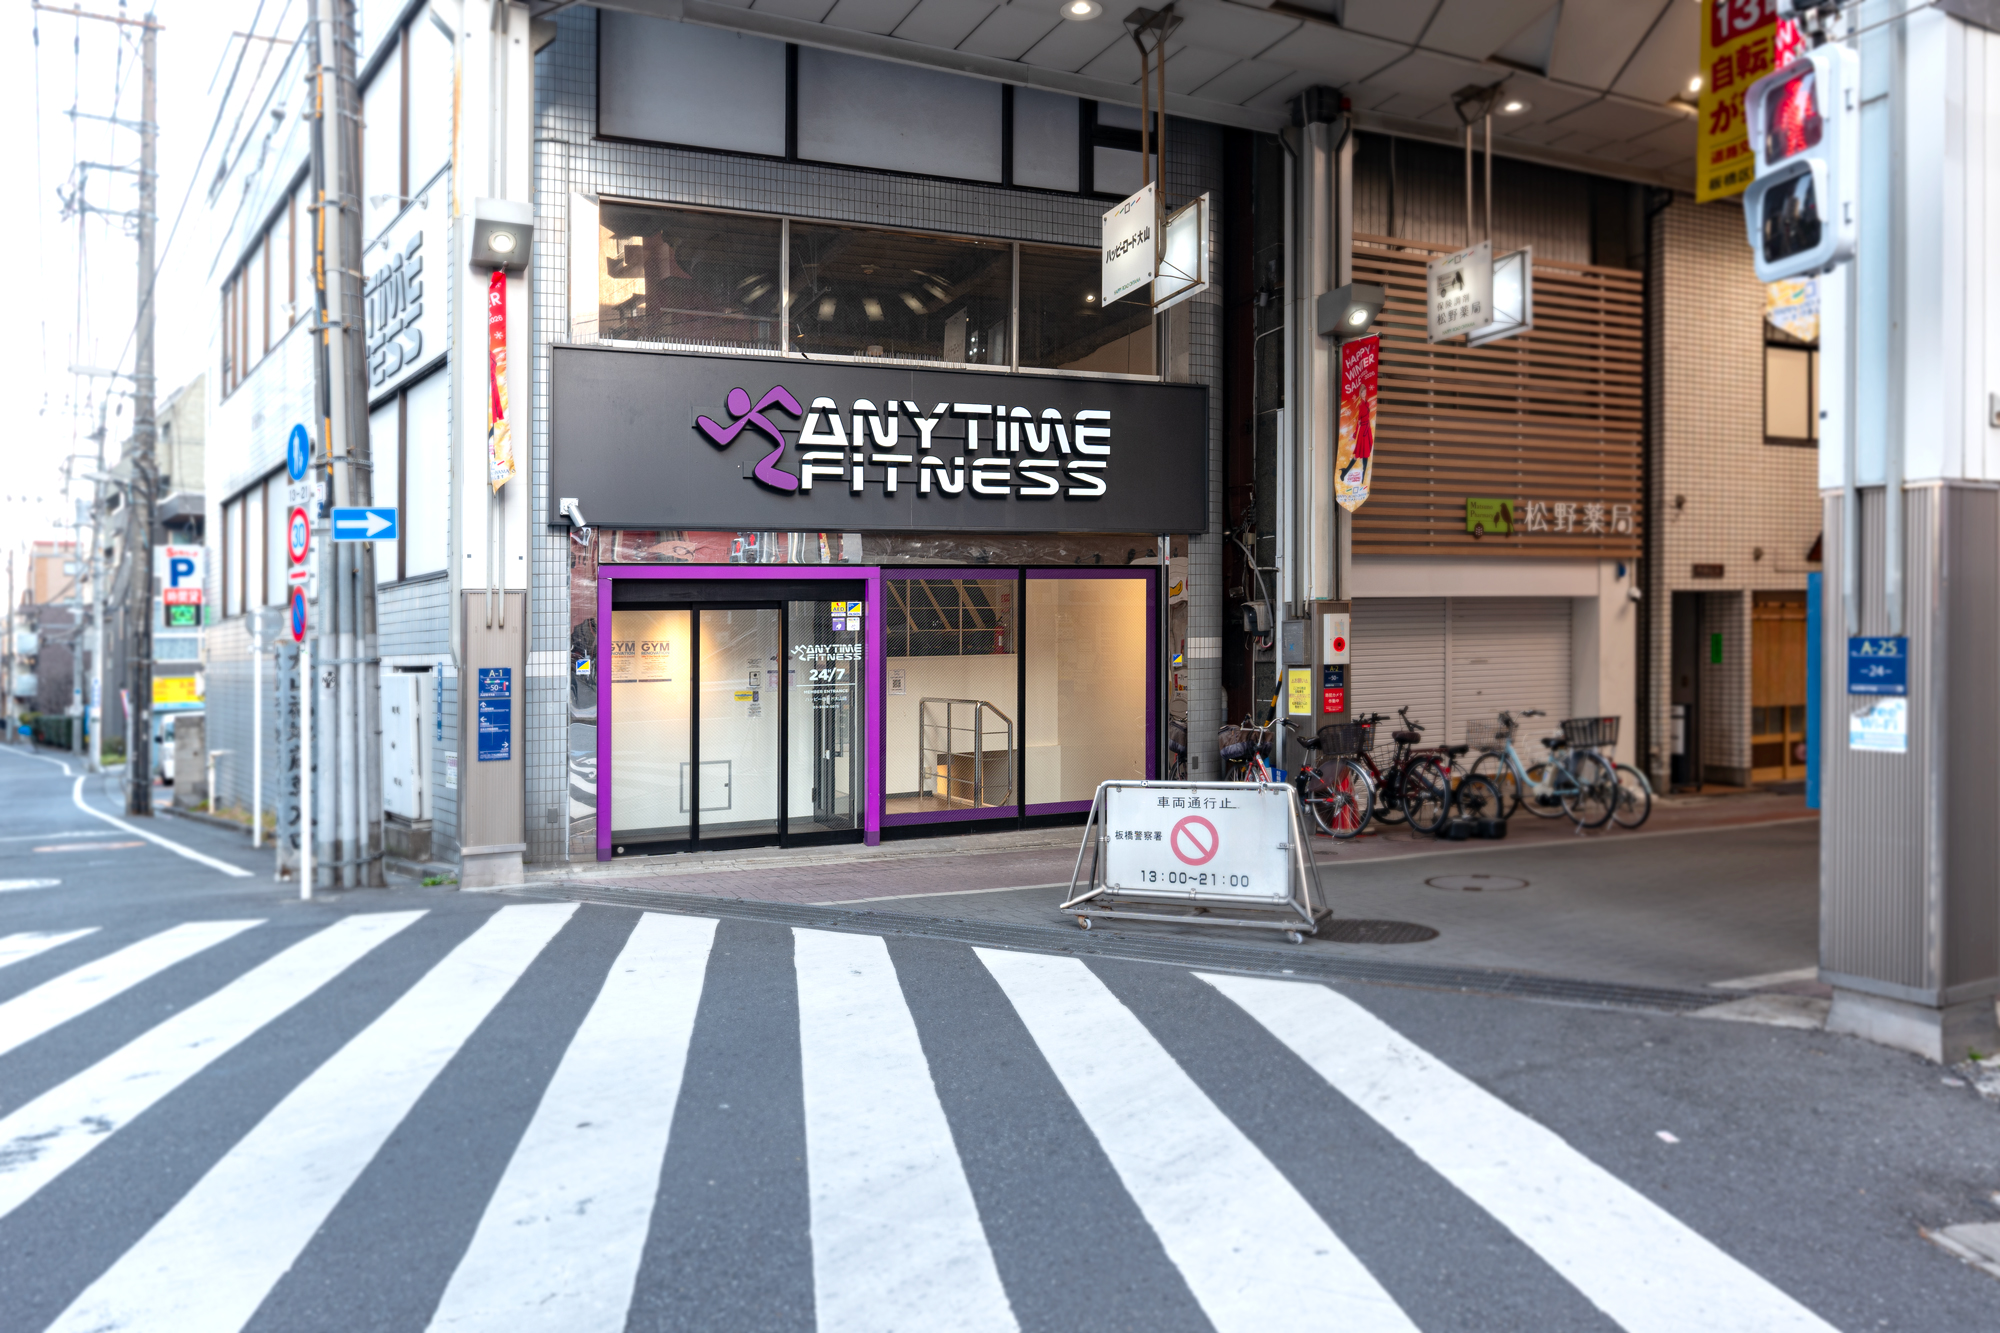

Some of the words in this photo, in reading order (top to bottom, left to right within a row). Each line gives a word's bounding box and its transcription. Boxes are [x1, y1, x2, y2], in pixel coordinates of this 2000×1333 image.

[1106, 226, 1151, 264] ハッピーロード大山
[1437, 301, 1481, 326] 松野薬局
[1345, 344, 1371, 369] HAPPY
[1345, 353, 1375, 381] WINTER
[1345, 375, 1361, 394] SALE
[798, 396, 1111, 455] ANYTIME
[801, 451, 1107, 496] FITNESS
[1470, 502, 1494, 510] Matsuno
[1523, 500, 1634, 534] 松野薬局
[293, 523, 305, 548] 30
[170, 558, 195, 587] P
[641, 642, 670, 652] GYM
[806, 644, 862, 654] ANYTIME
[807, 653, 862, 661] FITNESS
[1861, 640, 1897, 656] A-25
[489, 669, 503, 678] A-1
[1114, 830, 1163, 842] 板橋警察署
